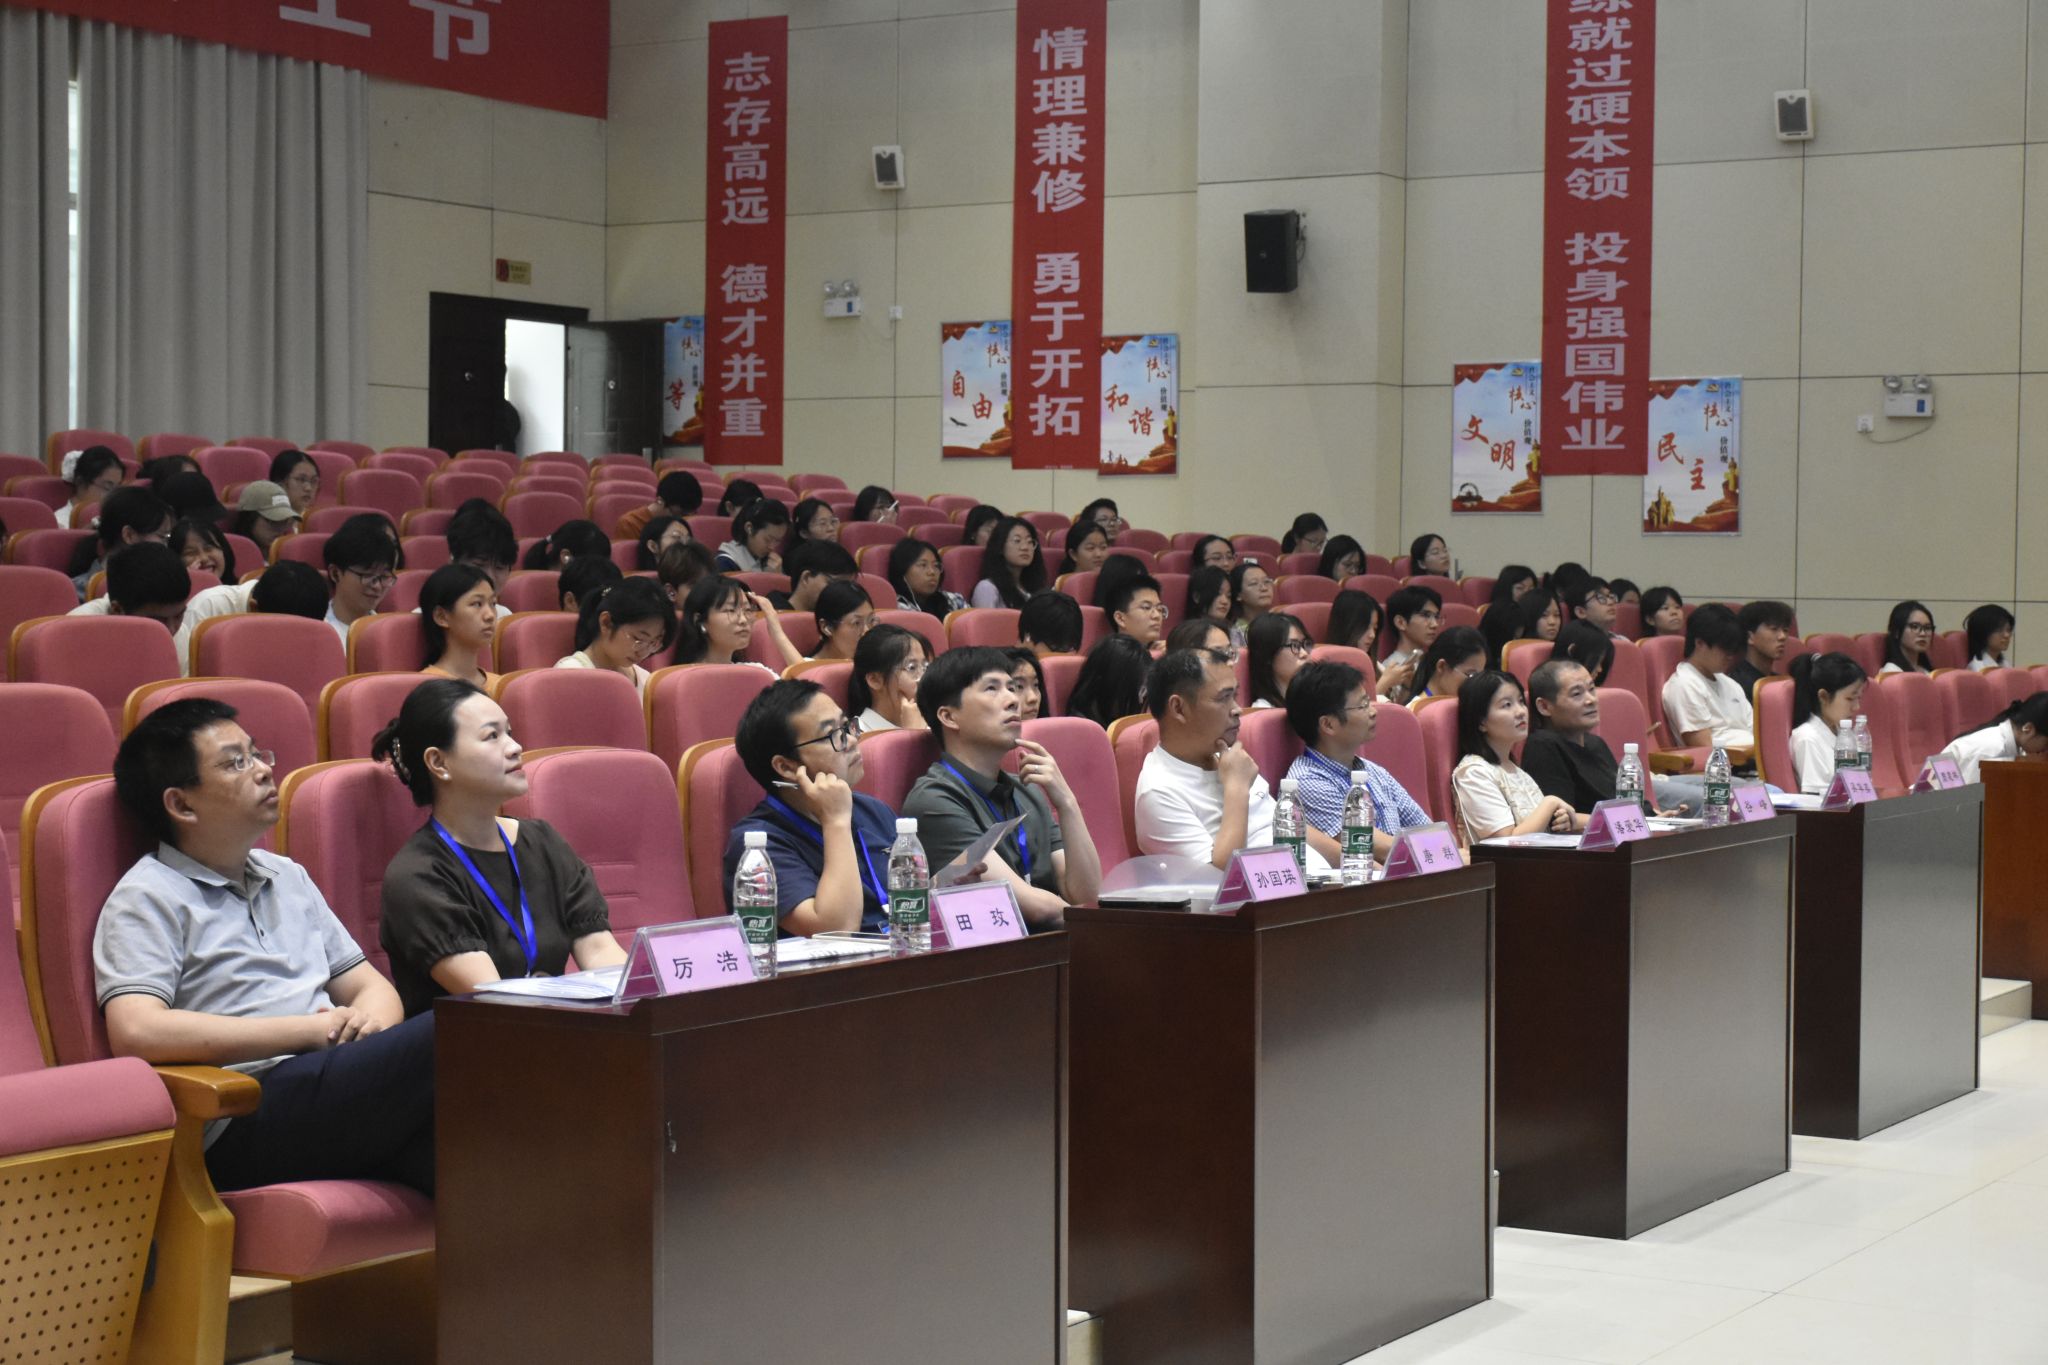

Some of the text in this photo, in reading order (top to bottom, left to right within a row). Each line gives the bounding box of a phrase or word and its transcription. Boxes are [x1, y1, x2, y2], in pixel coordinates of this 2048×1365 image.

[1032, 27, 1087, 212] 情理兼修
[720, 53, 770, 436] 志存高远 德才并重
[953, 370, 992, 420] 自由
[1029, 252, 1084, 435] 勇于开拓
[1563, 232, 1629, 450] 投身强国伟业
[1105, 384, 1154, 436] 和谐
[1461, 414, 1515, 471] 文明
[1658, 432, 1705, 490] 民主
